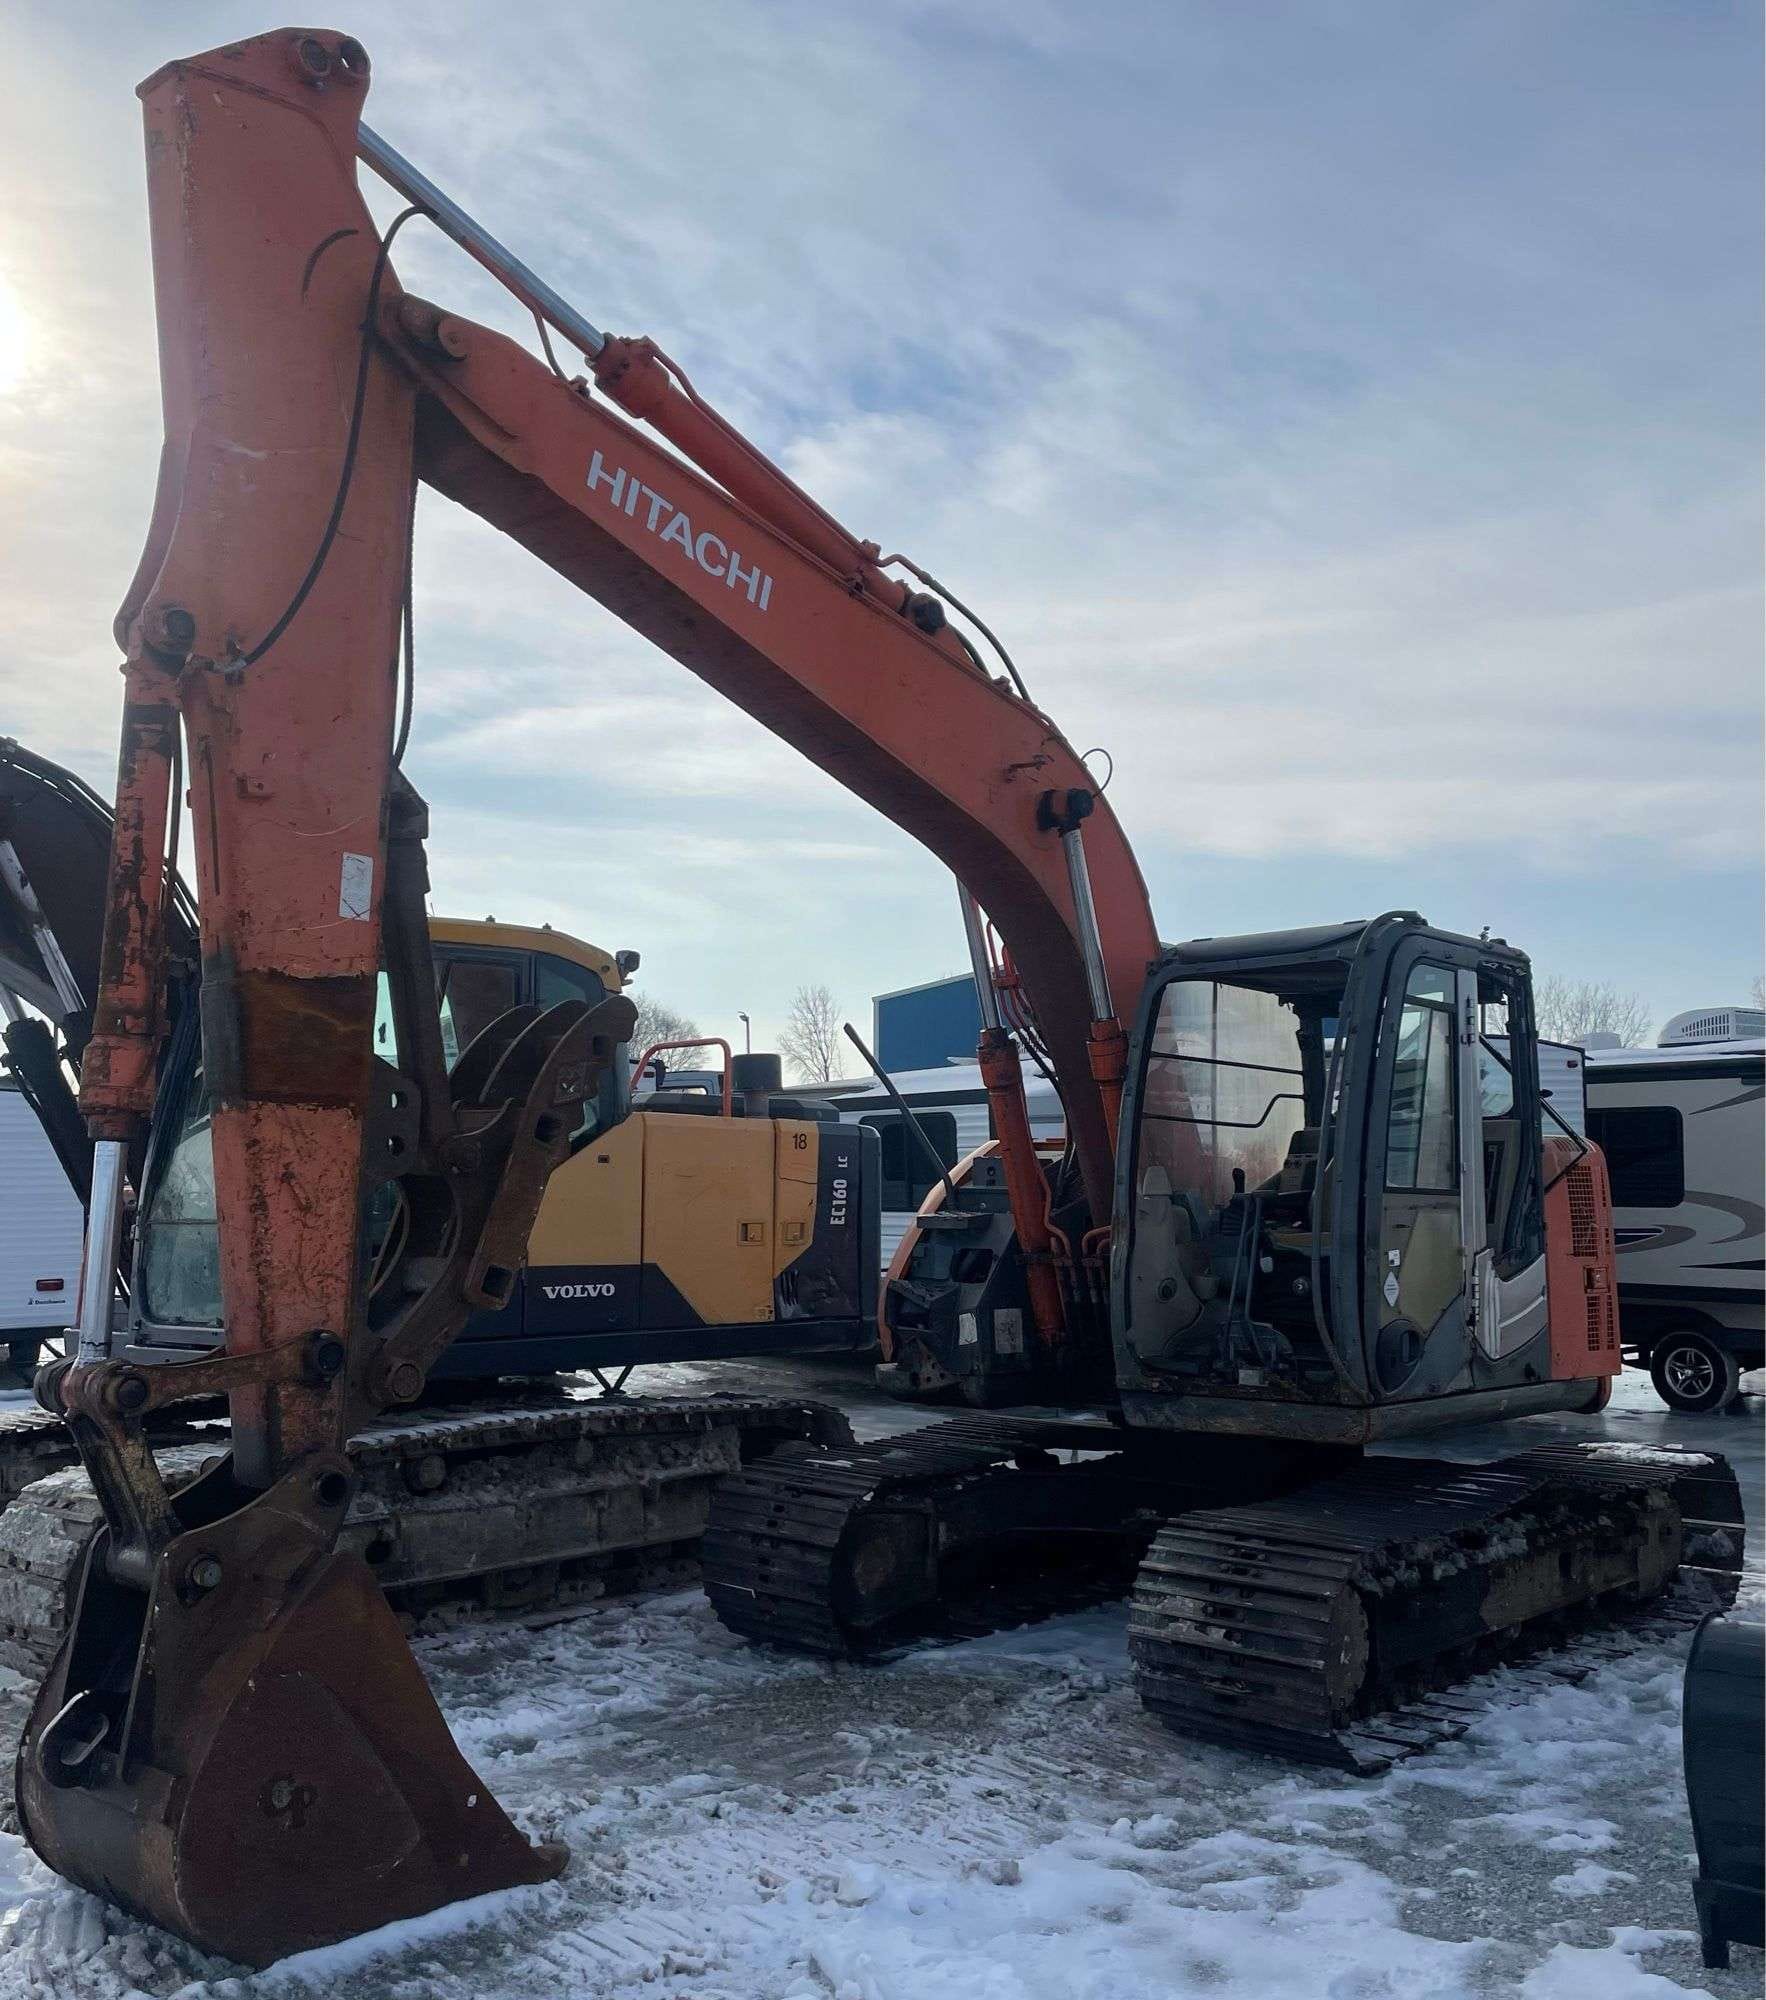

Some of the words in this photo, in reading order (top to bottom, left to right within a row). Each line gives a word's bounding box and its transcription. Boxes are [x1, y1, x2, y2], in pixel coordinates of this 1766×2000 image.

[586, 450, 774, 611] HITACHI
[792, 1133, 808, 1150] 18
[837, 1155, 848, 1168] LC
[829, 1179, 848, 1225] EC160
[542, 1283, 616, 1299] VOLVO
